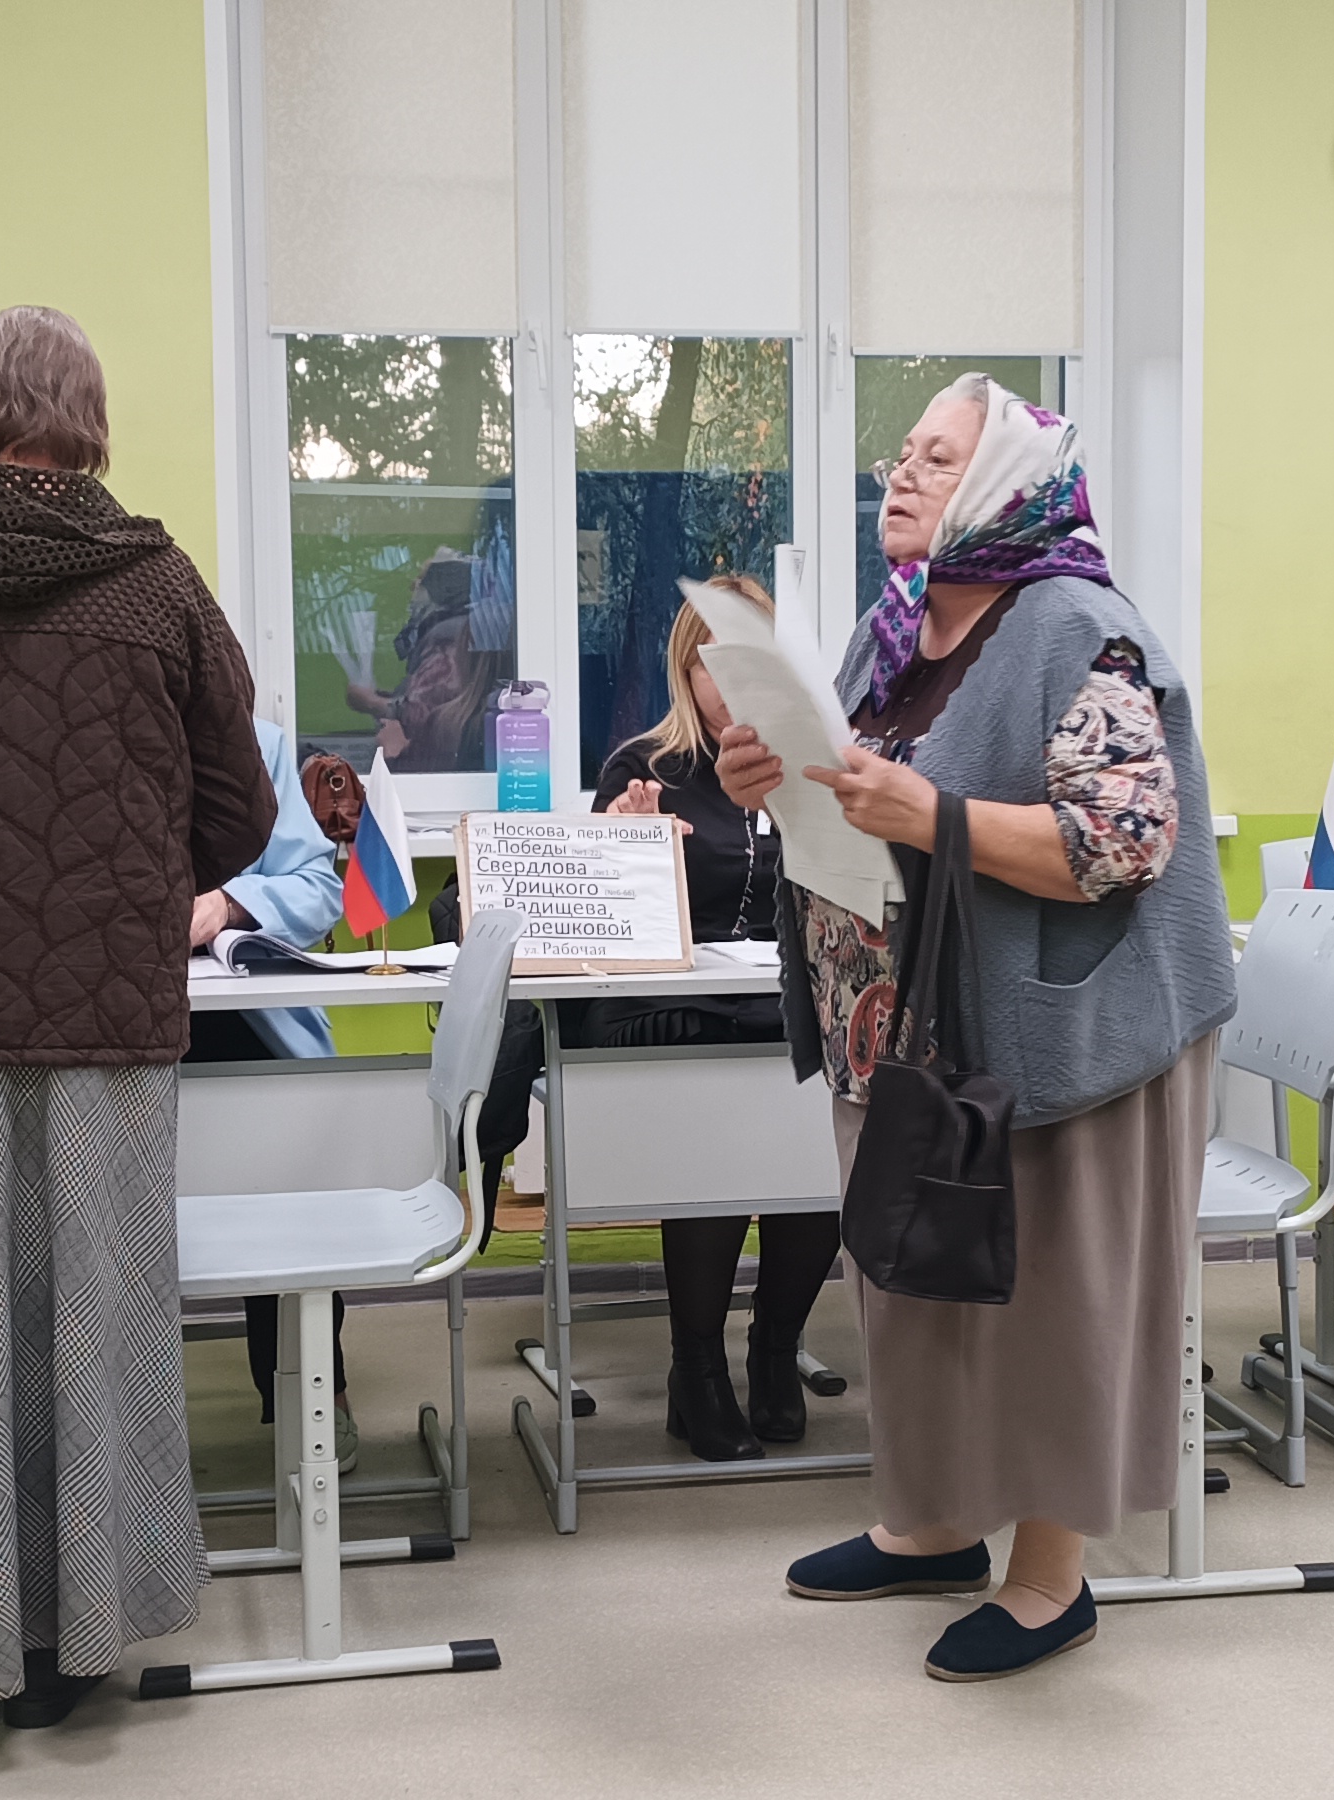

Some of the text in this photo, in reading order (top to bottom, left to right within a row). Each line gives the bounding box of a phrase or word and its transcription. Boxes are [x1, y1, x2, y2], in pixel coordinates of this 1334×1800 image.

[474, 826, 490, 837] ул.
[494, 822, 570, 840] Носкова,
[477, 857, 587, 876] Свердлова
[478, 883, 498, 895] ул.
[502, 877, 599, 897] Урицкого
[504, 897, 614, 918] Радищева,
[524, 919, 633, 937] решковой
[524, 941, 607, 956] ул. Рабочая
